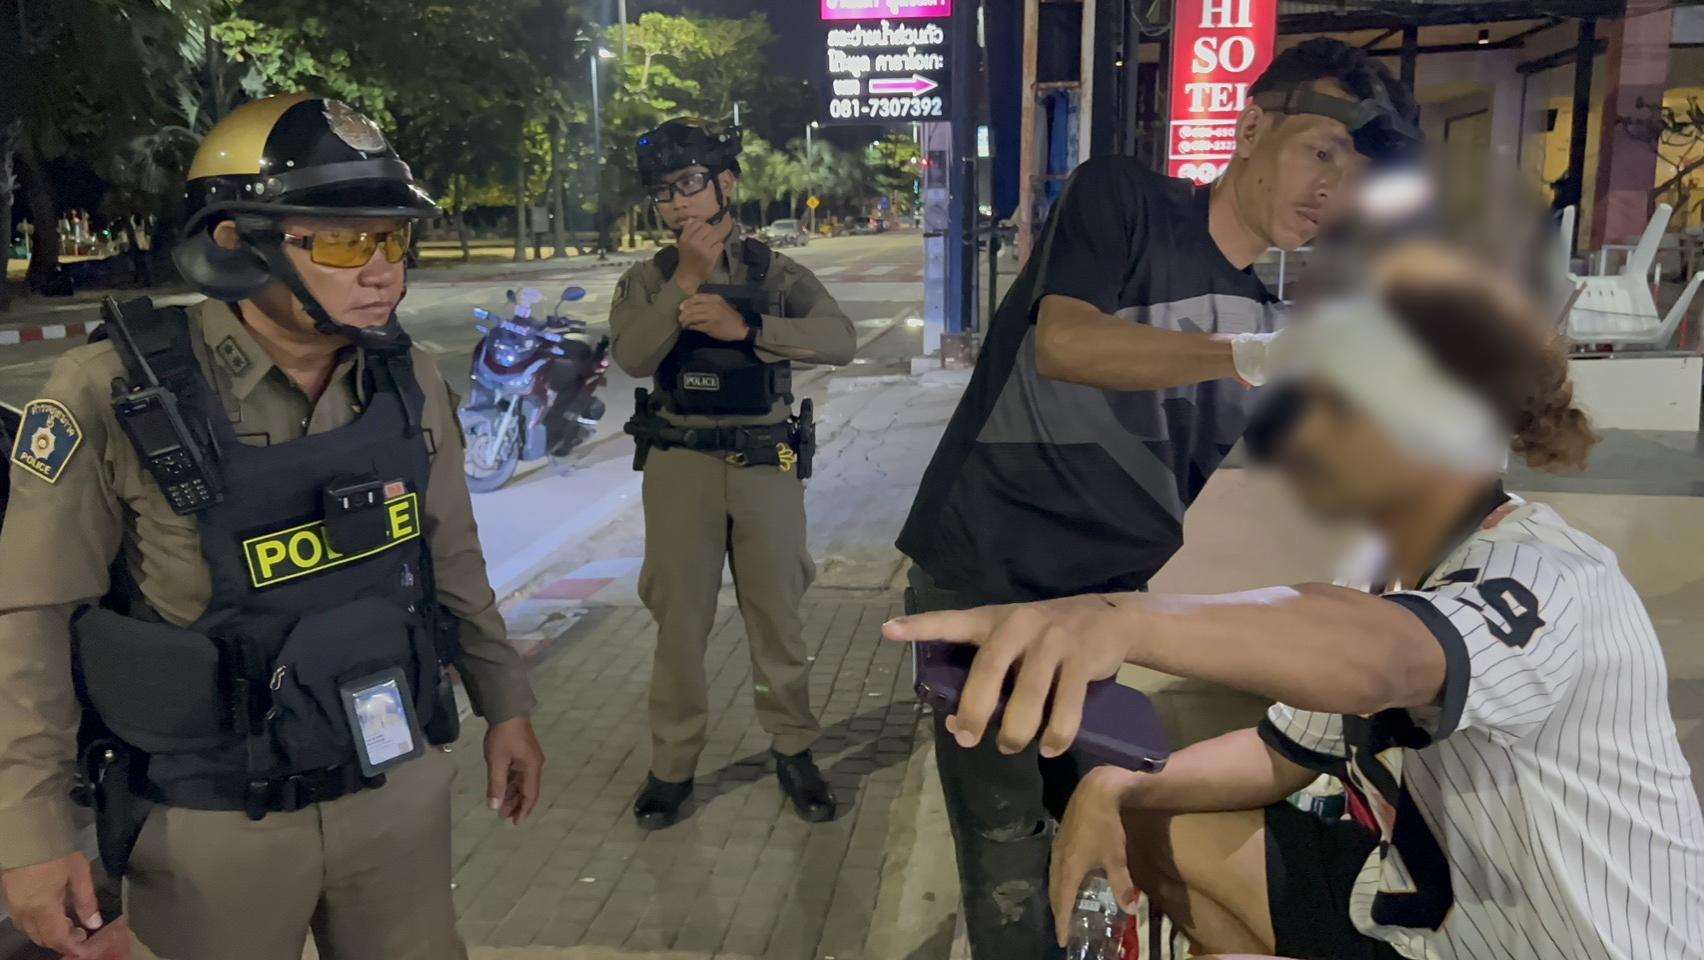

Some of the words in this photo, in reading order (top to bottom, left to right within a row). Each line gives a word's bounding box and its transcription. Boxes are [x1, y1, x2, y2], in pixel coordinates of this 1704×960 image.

[1191, 35, 1255, 74] SO
[829, 96, 943, 118] 081-7307392
[20, 451, 52, 475] POLICE
